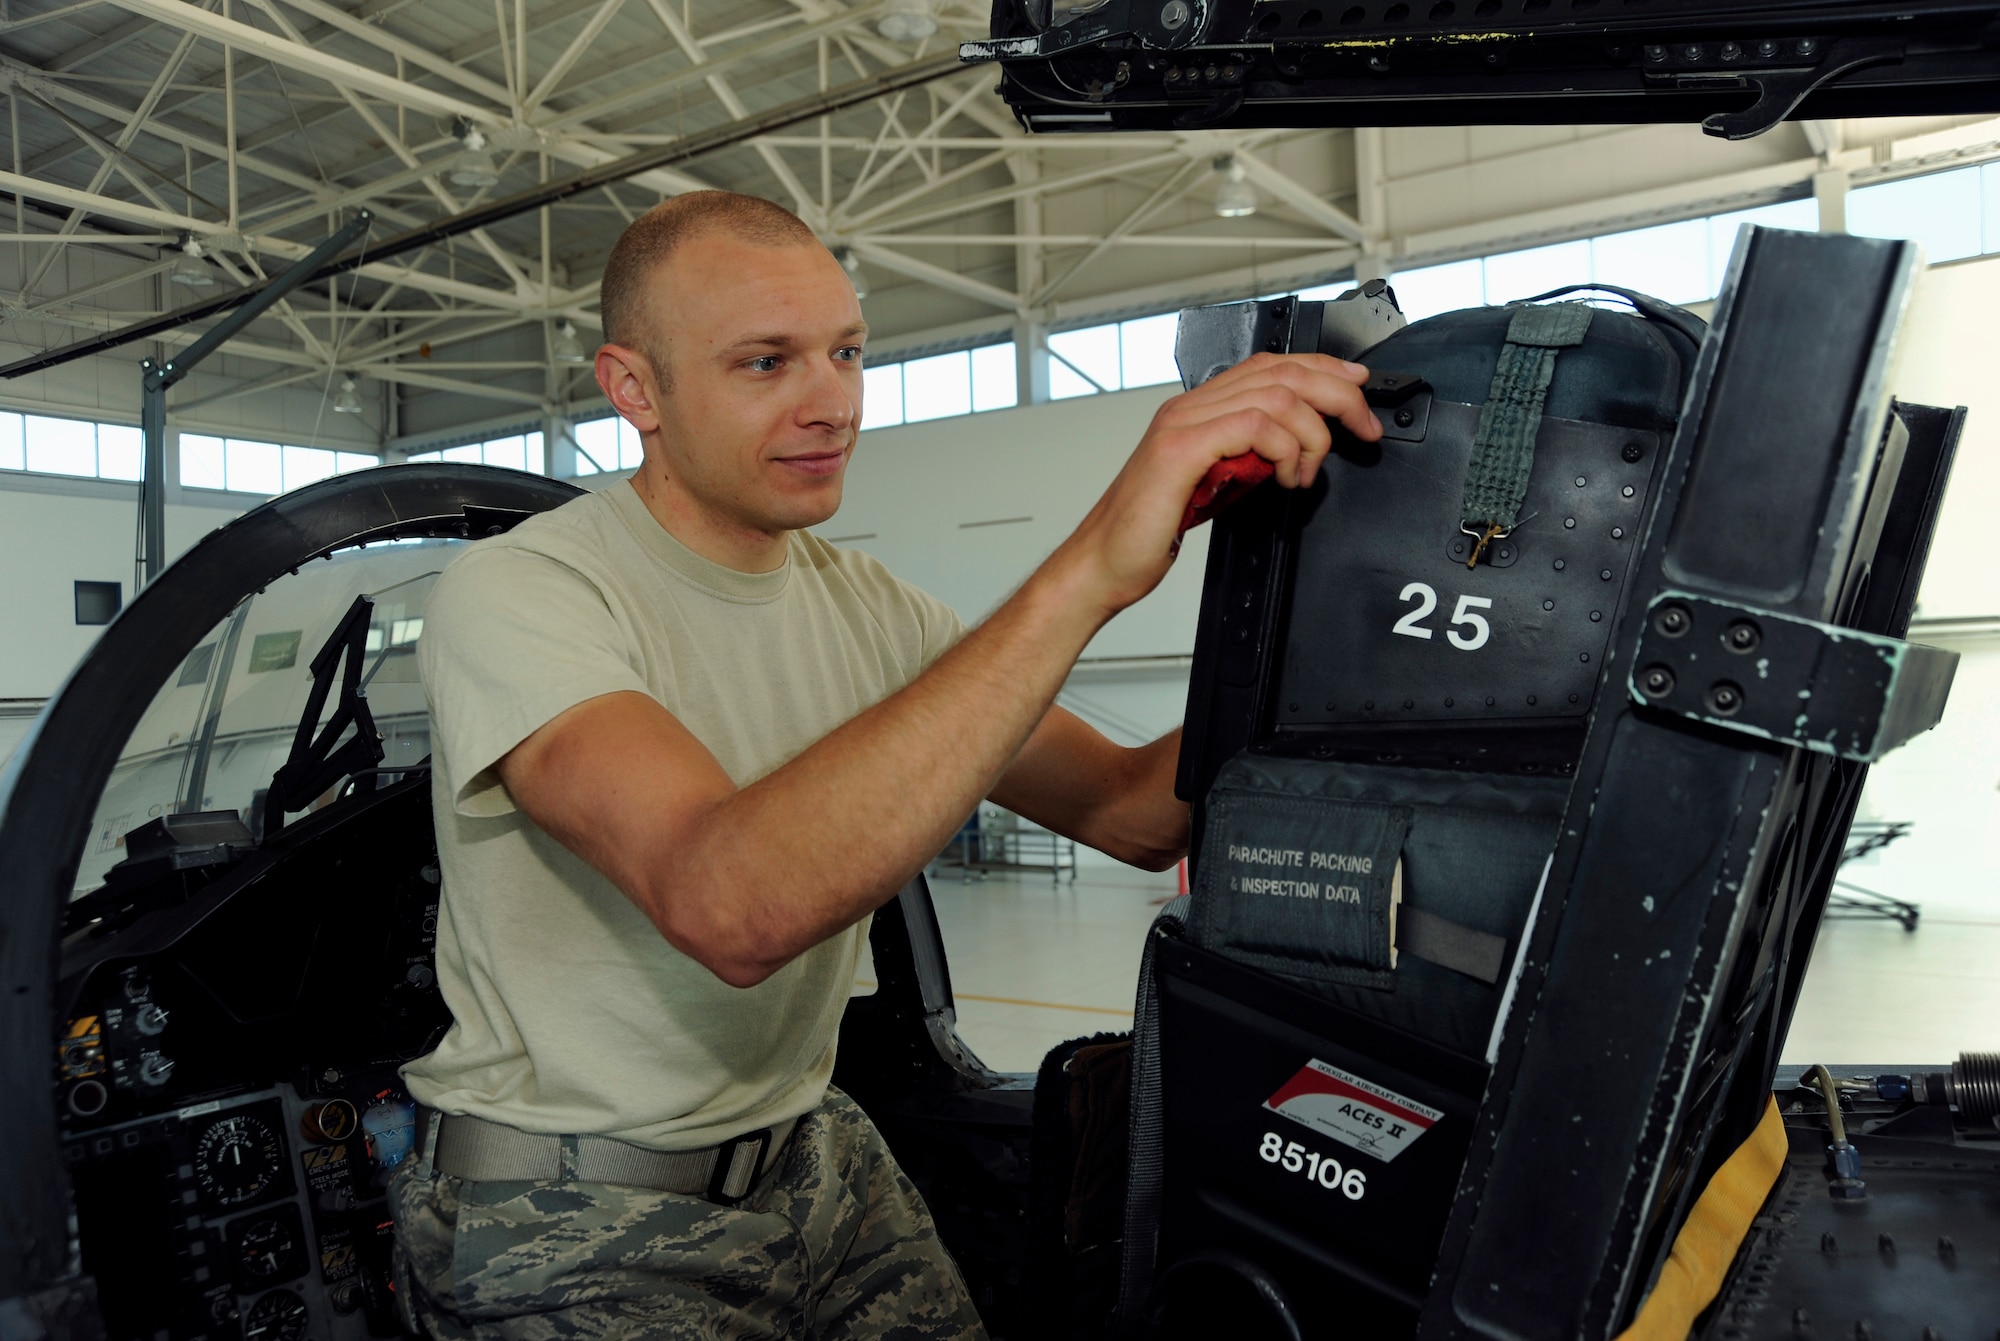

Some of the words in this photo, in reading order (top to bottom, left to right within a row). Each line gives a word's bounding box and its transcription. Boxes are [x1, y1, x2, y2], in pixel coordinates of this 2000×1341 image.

[1392, 582, 1492, 651] 25
[1229, 844, 1304, 867] PARACHUTE
[1310, 851, 1373, 874] PACKING
[1230, 876, 1238, 892] &
[1241, 877, 1319, 899] INSPECTION
[1325, 884, 1360, 904] DATA
[1317, 1064, 1353, 1084] DOUGLAS
[1355, 1079, 1396, 1102] AIRCRAFT
[1397, 1098, 1438, 1120] COMPANY
[1338, 1103, 1385, 1130] ACES
[1387, 1123, 1407, 1140] II
[1259, 1132, 1367, 1201] 85106
